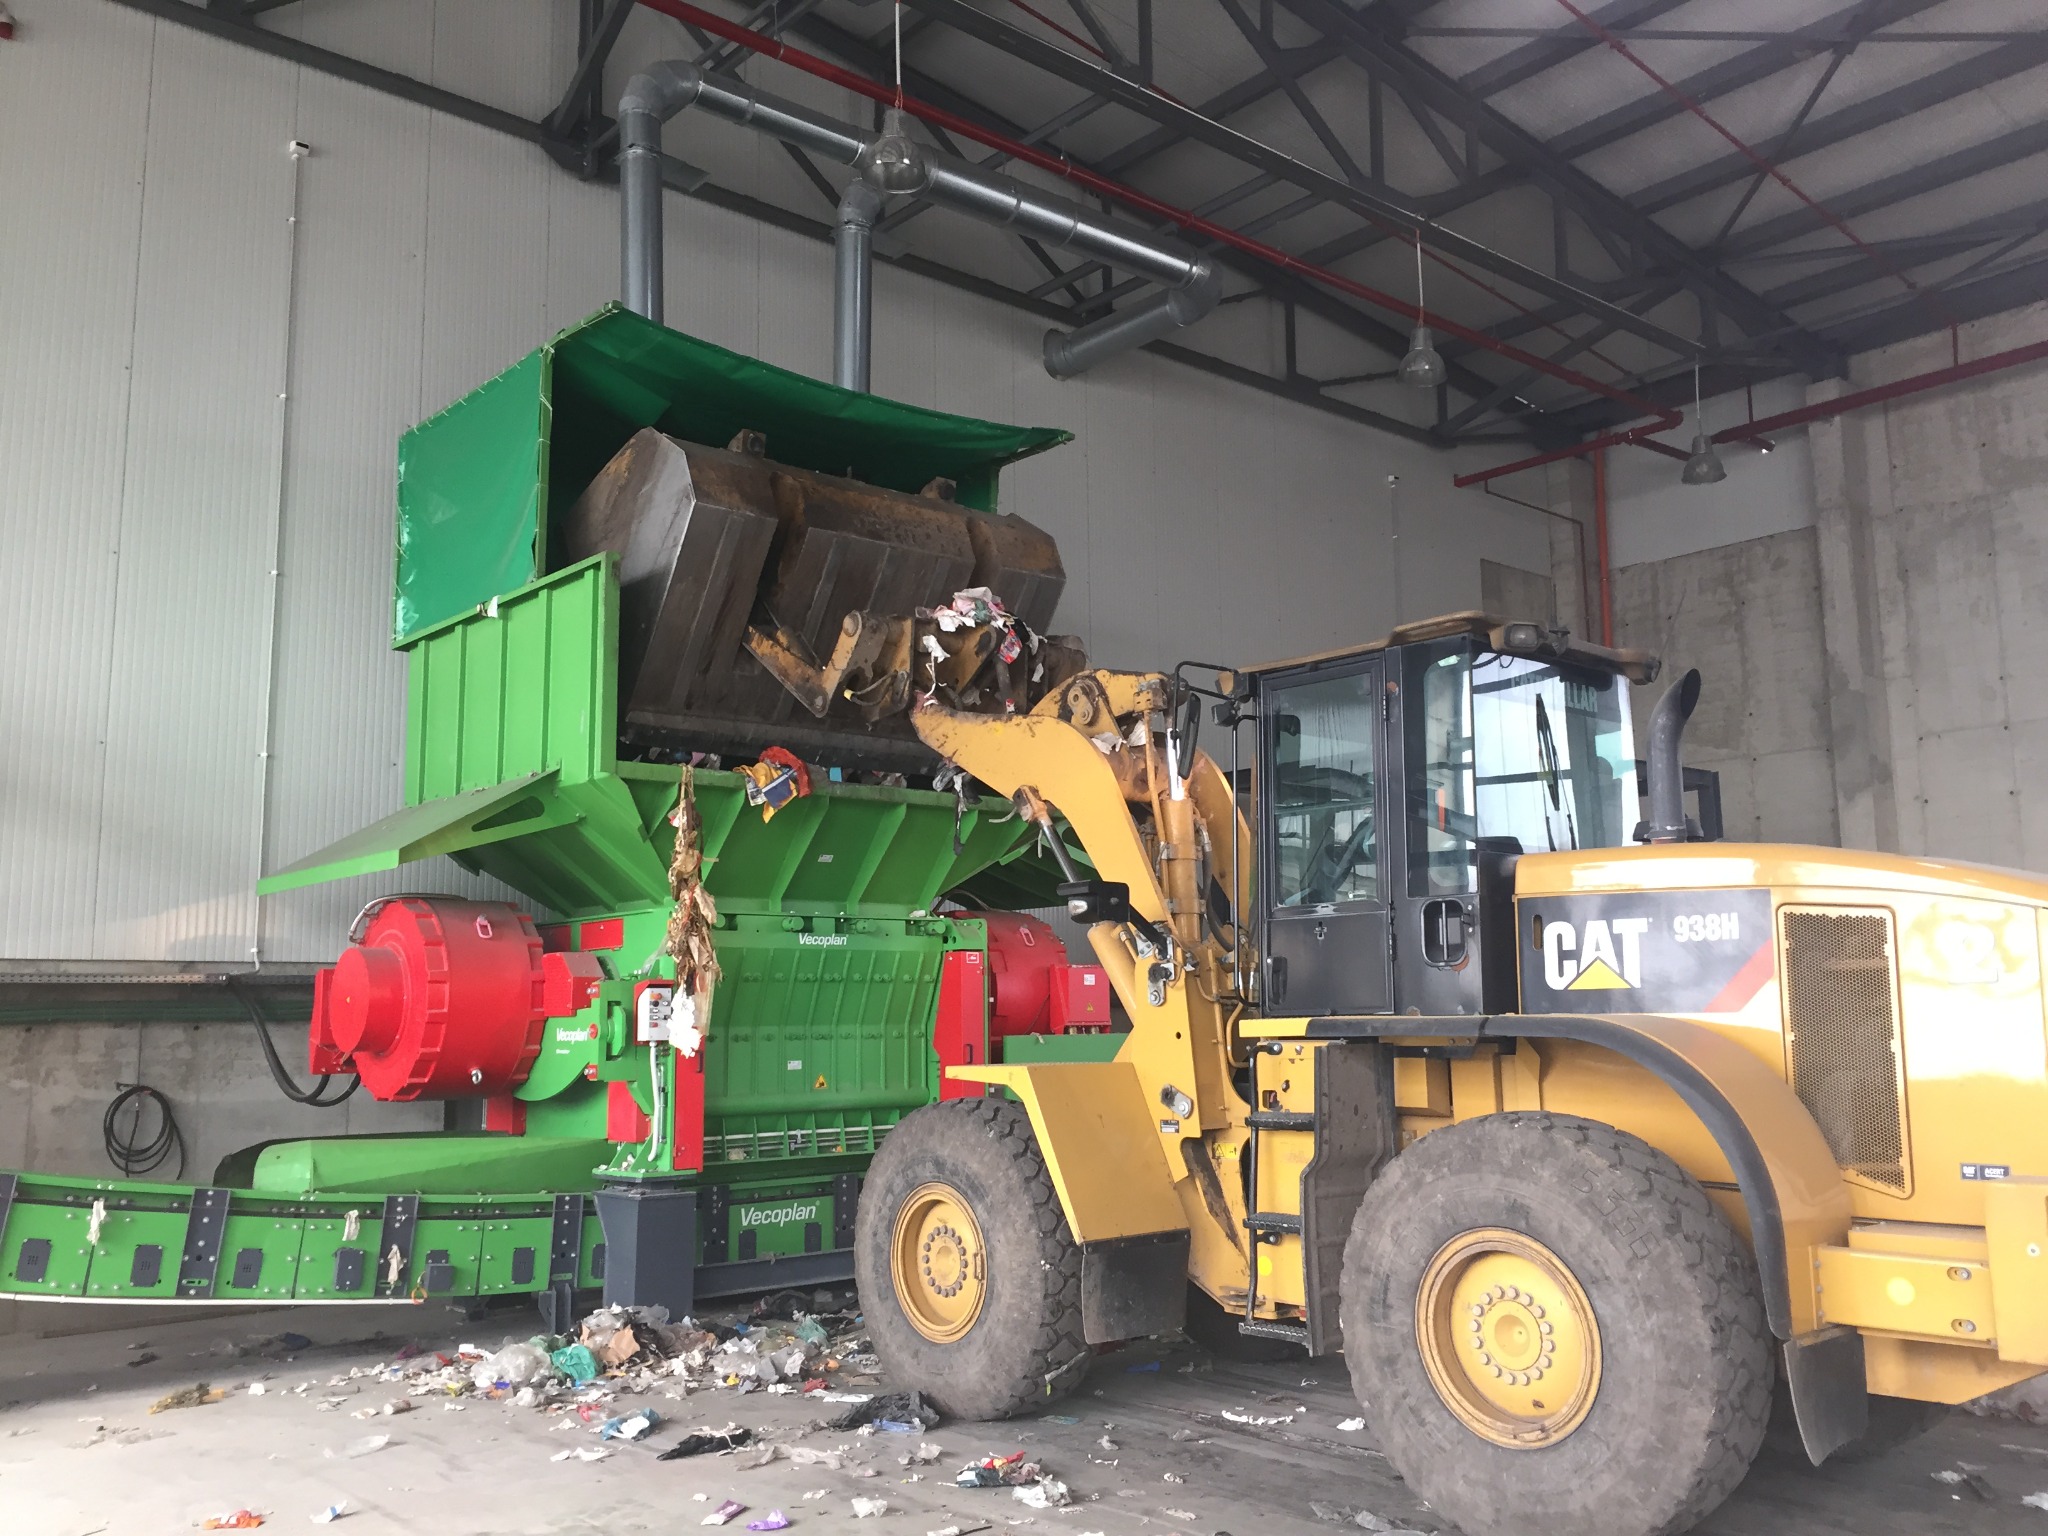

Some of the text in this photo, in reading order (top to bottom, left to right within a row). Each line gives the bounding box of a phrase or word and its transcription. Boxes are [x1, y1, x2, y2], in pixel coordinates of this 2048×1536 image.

[799, 933, 847, 948] Vecoplan
[1544, 912, 1740, 990] CAT 938H
[741, 1203, 817, 1227] Vecoplan
